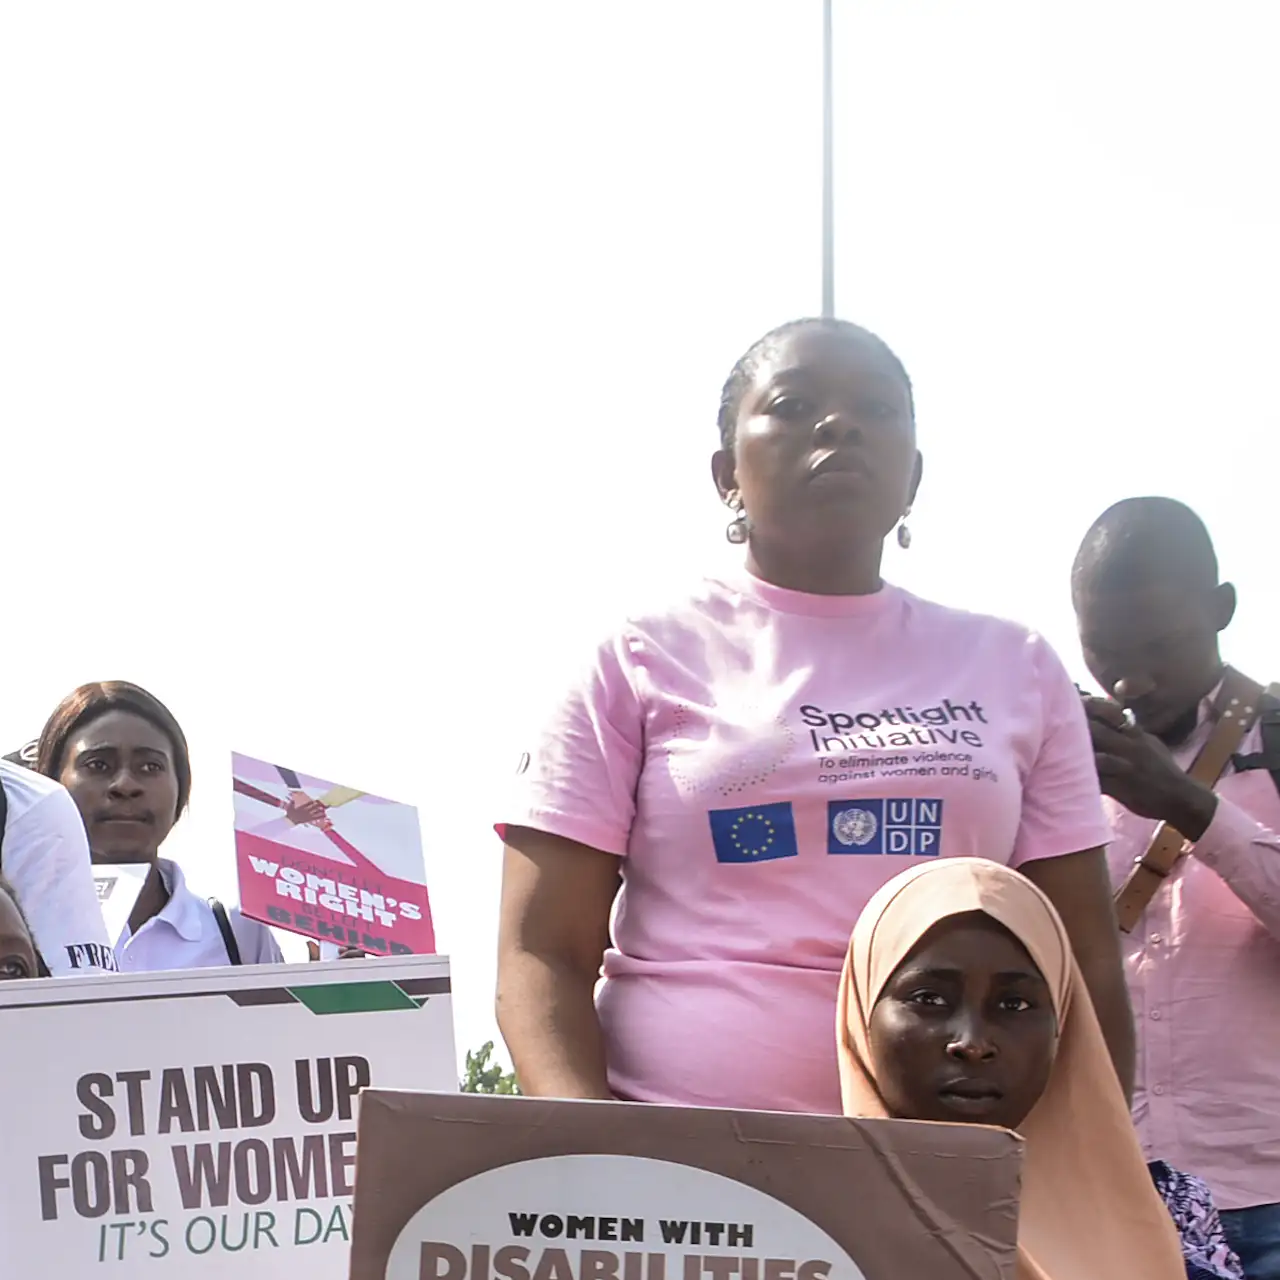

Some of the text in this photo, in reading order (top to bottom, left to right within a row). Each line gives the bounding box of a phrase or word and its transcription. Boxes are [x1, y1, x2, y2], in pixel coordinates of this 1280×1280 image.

[799, 698, 988, 734] Spotlight
[810, 725, 983, 752] Initiative
[818, 751, 973, 769] To eliminate violence
[818, 764, 999, 784] against women and girls
[247, 854, 422, 921] WOMEN'S
[275, 879, 397, 928] RIGHT
[75, 1055, 371, 1140] STAND UP
[37, 1131, 358, 1221] FOR WOME
[98, 1204, 357, 1262] IT'S OUR DA
[508, 1212, 754, 1248] WOMEN WITH
